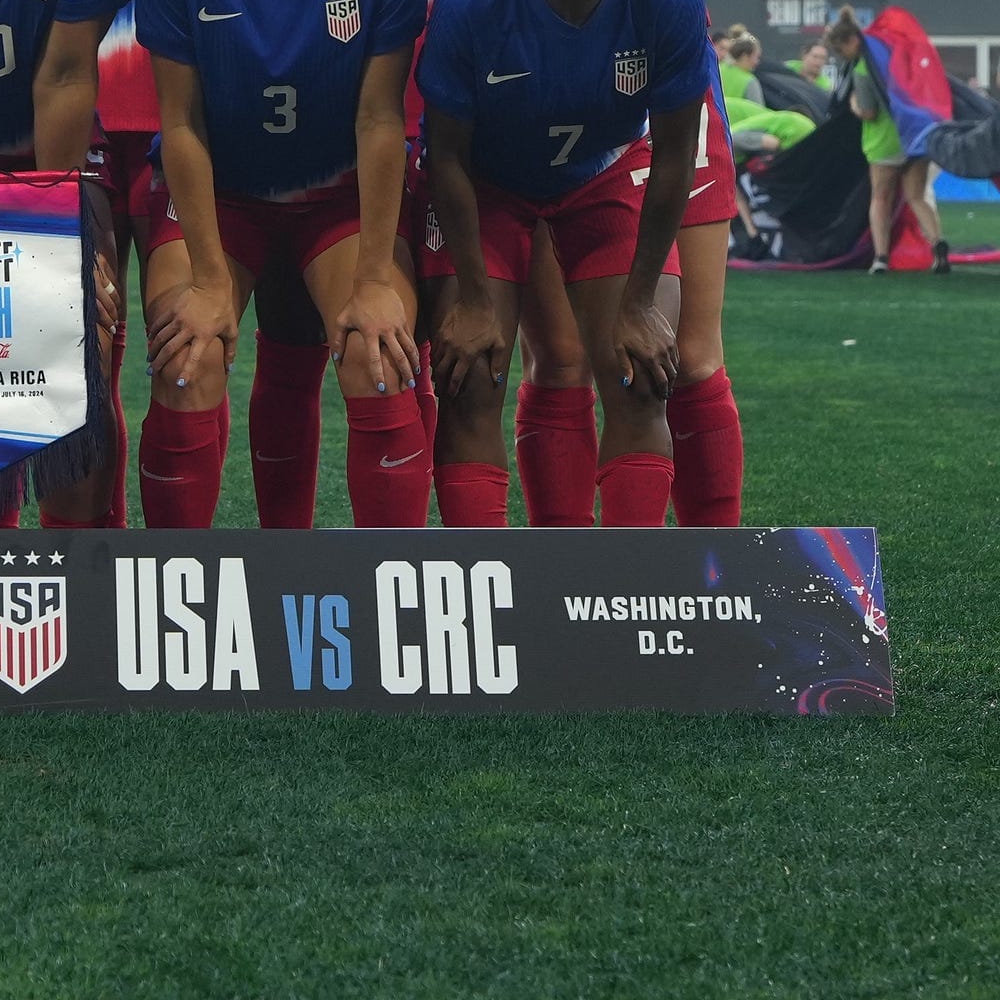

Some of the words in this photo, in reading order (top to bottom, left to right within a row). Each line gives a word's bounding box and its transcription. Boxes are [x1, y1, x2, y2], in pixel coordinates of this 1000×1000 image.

[328, 0, 357, 18] USA
[617, 60, 646, 76] USA
[263, 85, 296, 133] 3
[548, 125, 584, 166] 7
[10, 370, 46, 386] RICA
[564, 596, 763, 624] WASHINGTON,
[115, 557, 260, 691] USA
[375, 560, 519, 695] CRC
[638, 631, 695, 655] D.C.
